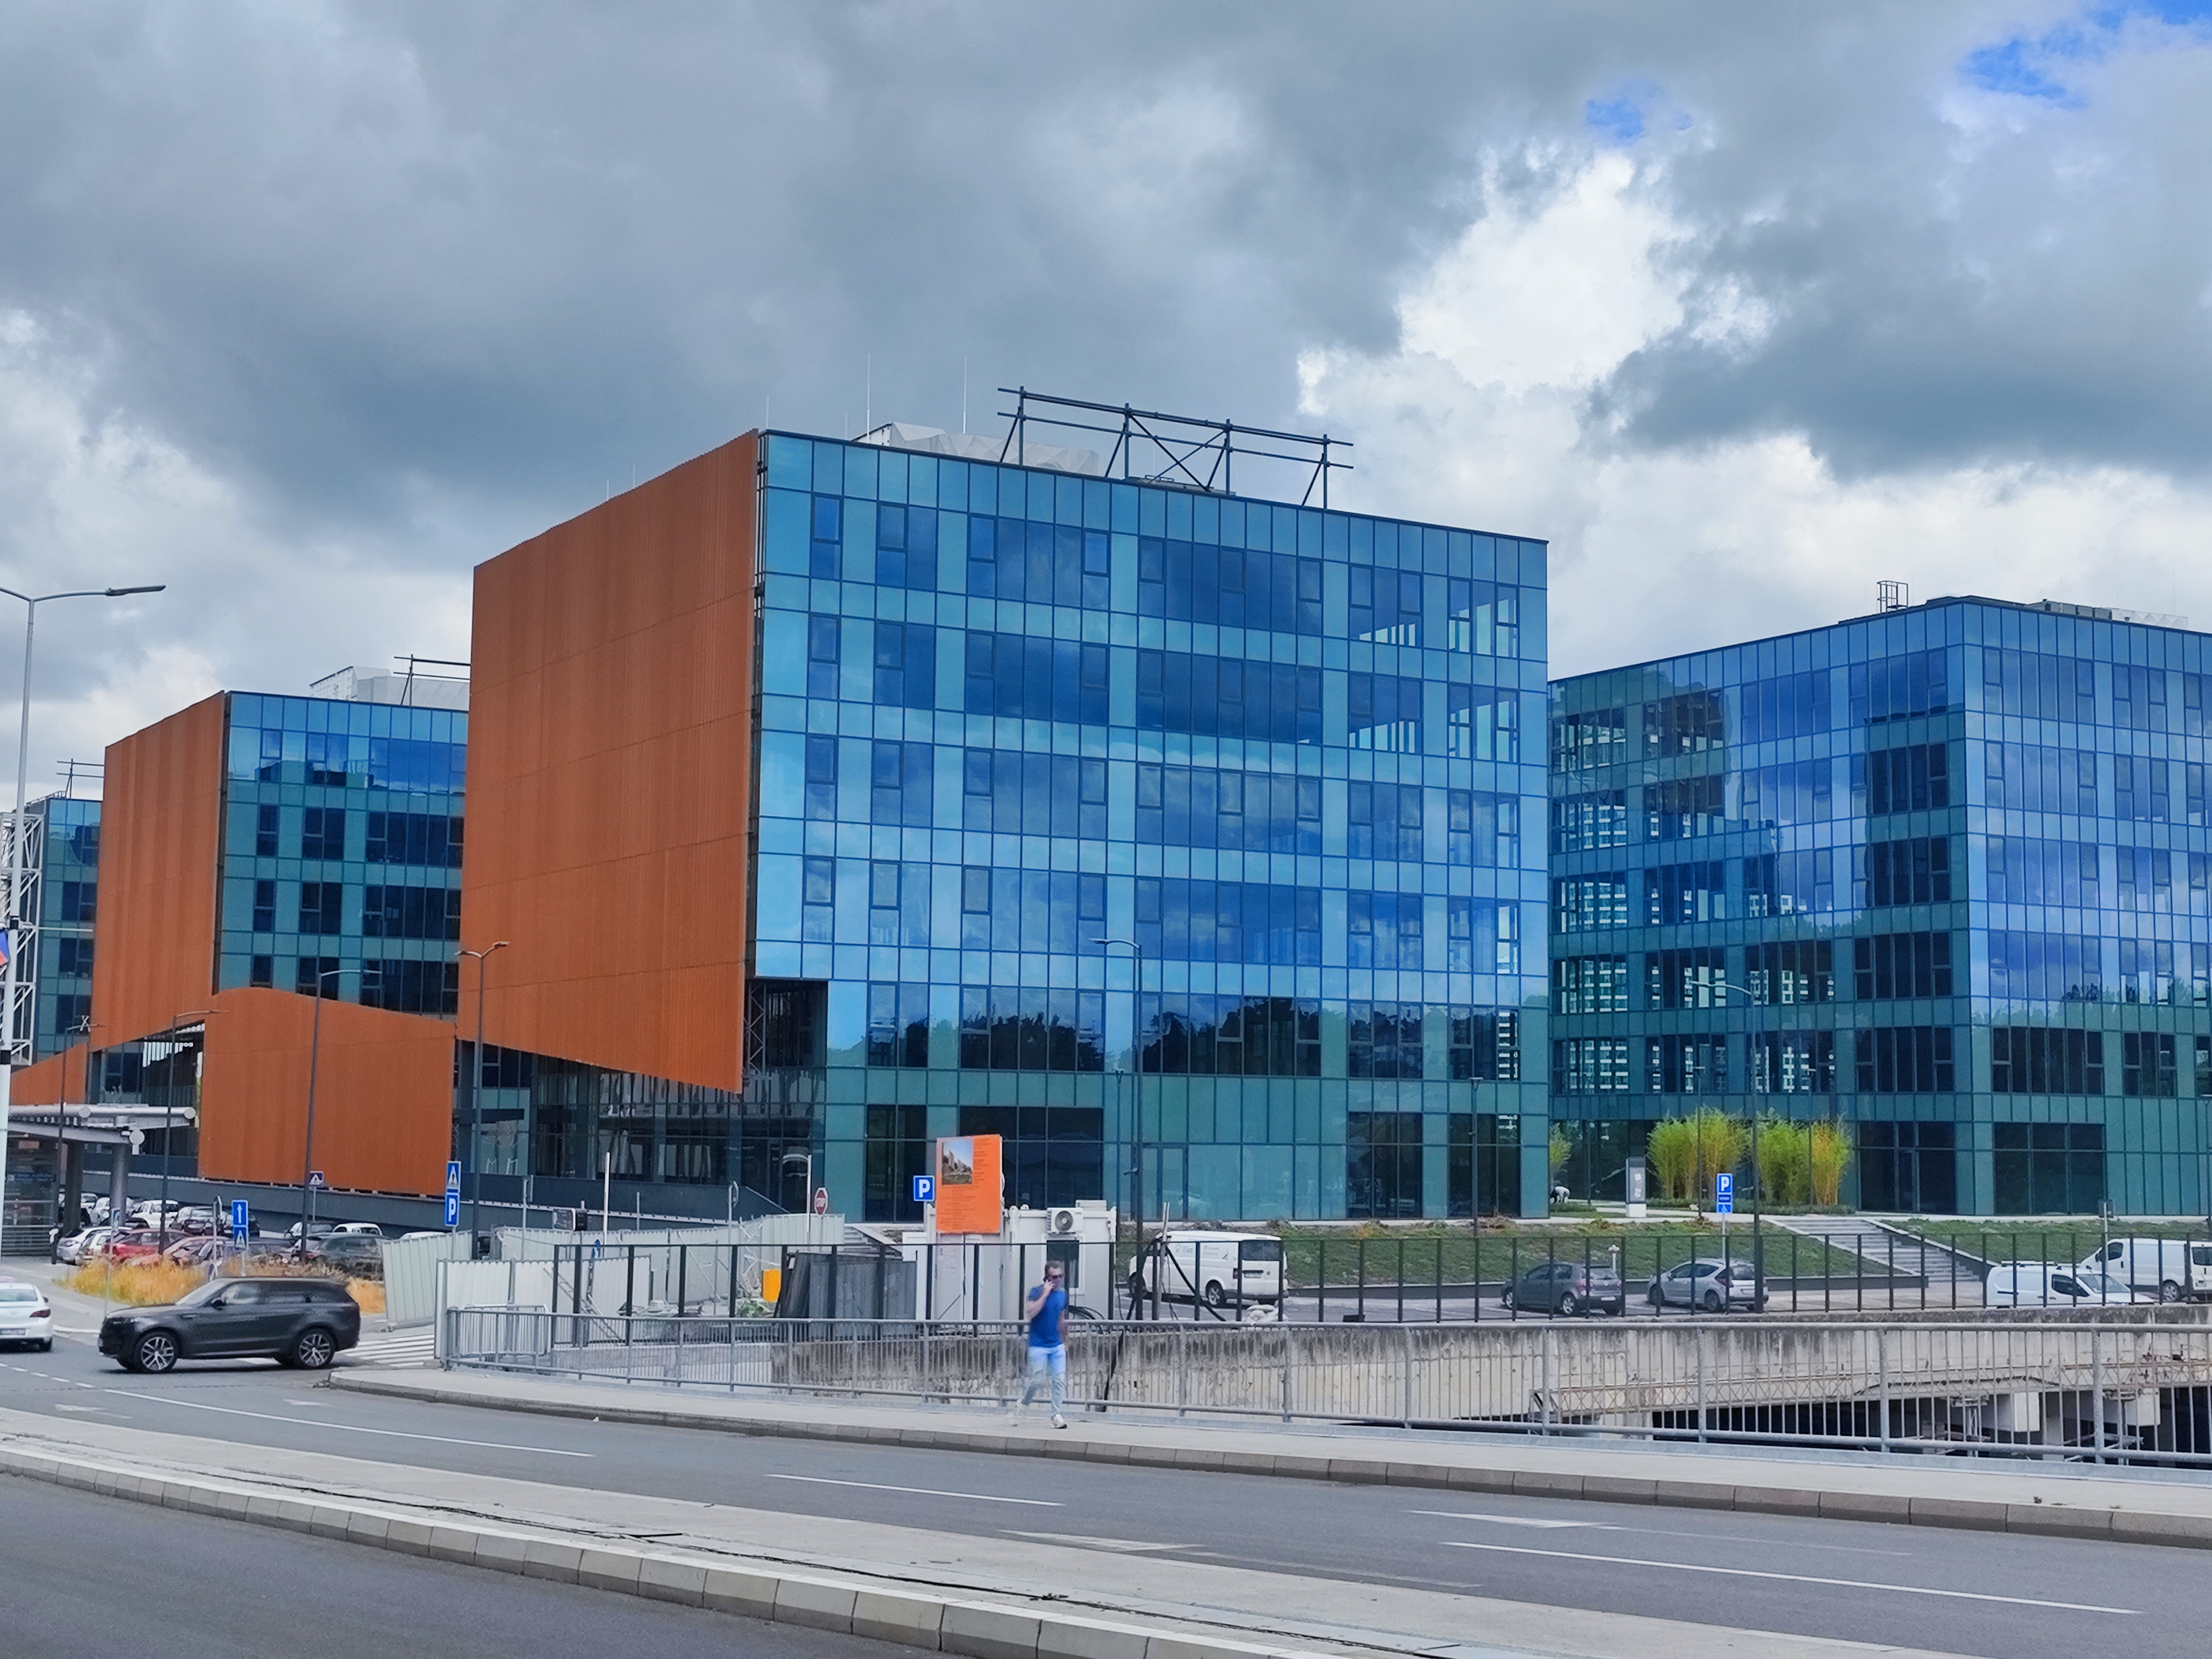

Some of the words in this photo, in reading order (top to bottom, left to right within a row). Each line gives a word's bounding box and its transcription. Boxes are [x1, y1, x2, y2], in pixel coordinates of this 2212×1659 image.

[919, 1179, 930, 1198] P
[1721, 1176, 1730, 1191] P
[448, 1198, 456, 1222] P
